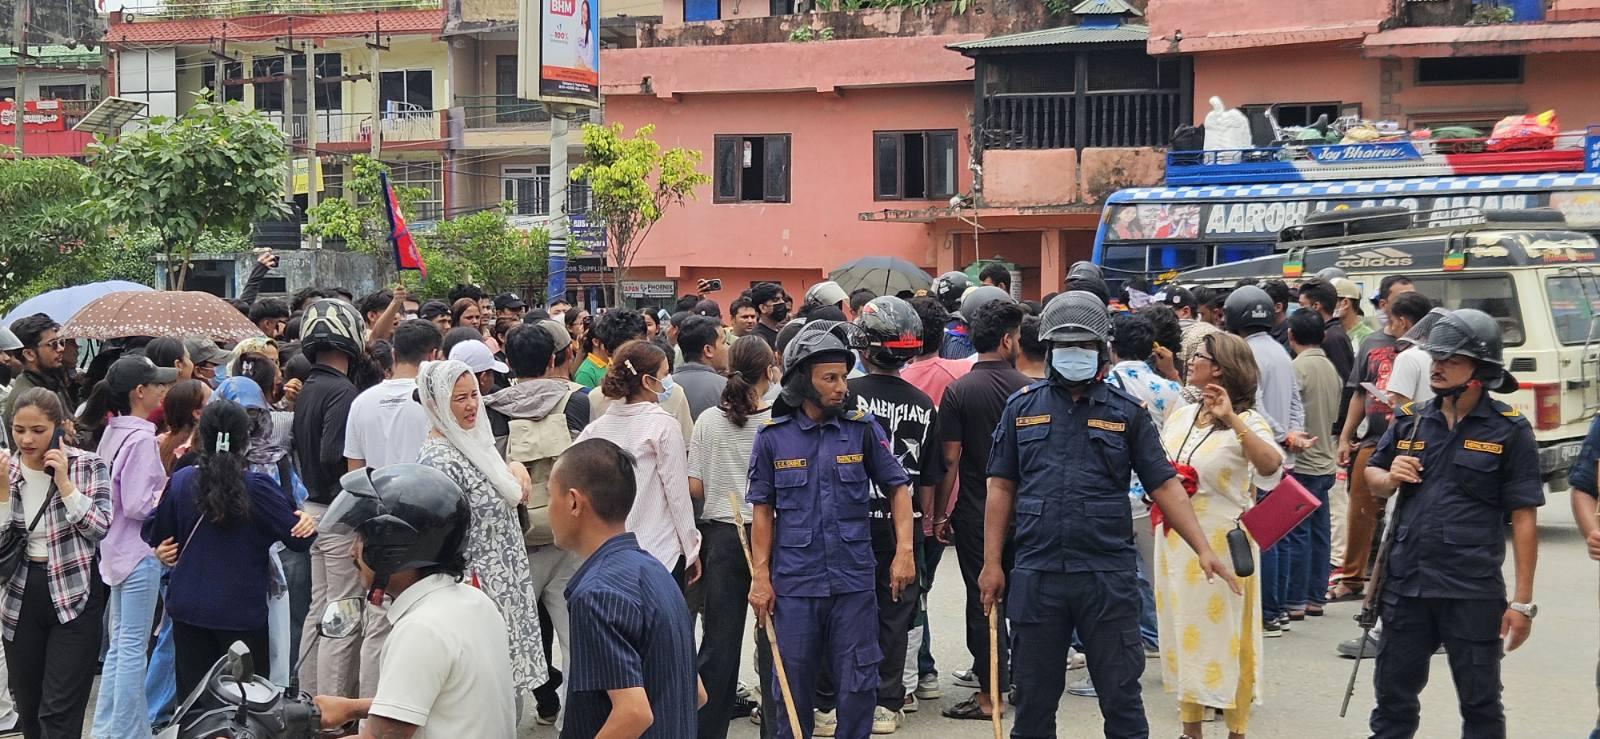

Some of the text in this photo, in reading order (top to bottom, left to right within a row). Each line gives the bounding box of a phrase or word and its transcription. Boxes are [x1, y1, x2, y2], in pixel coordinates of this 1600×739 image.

[552, 0, 571, 14] BHM
[1335, 257, 1413, 268] adidas
[856, 394, 932, 446] BALENCIAGA
